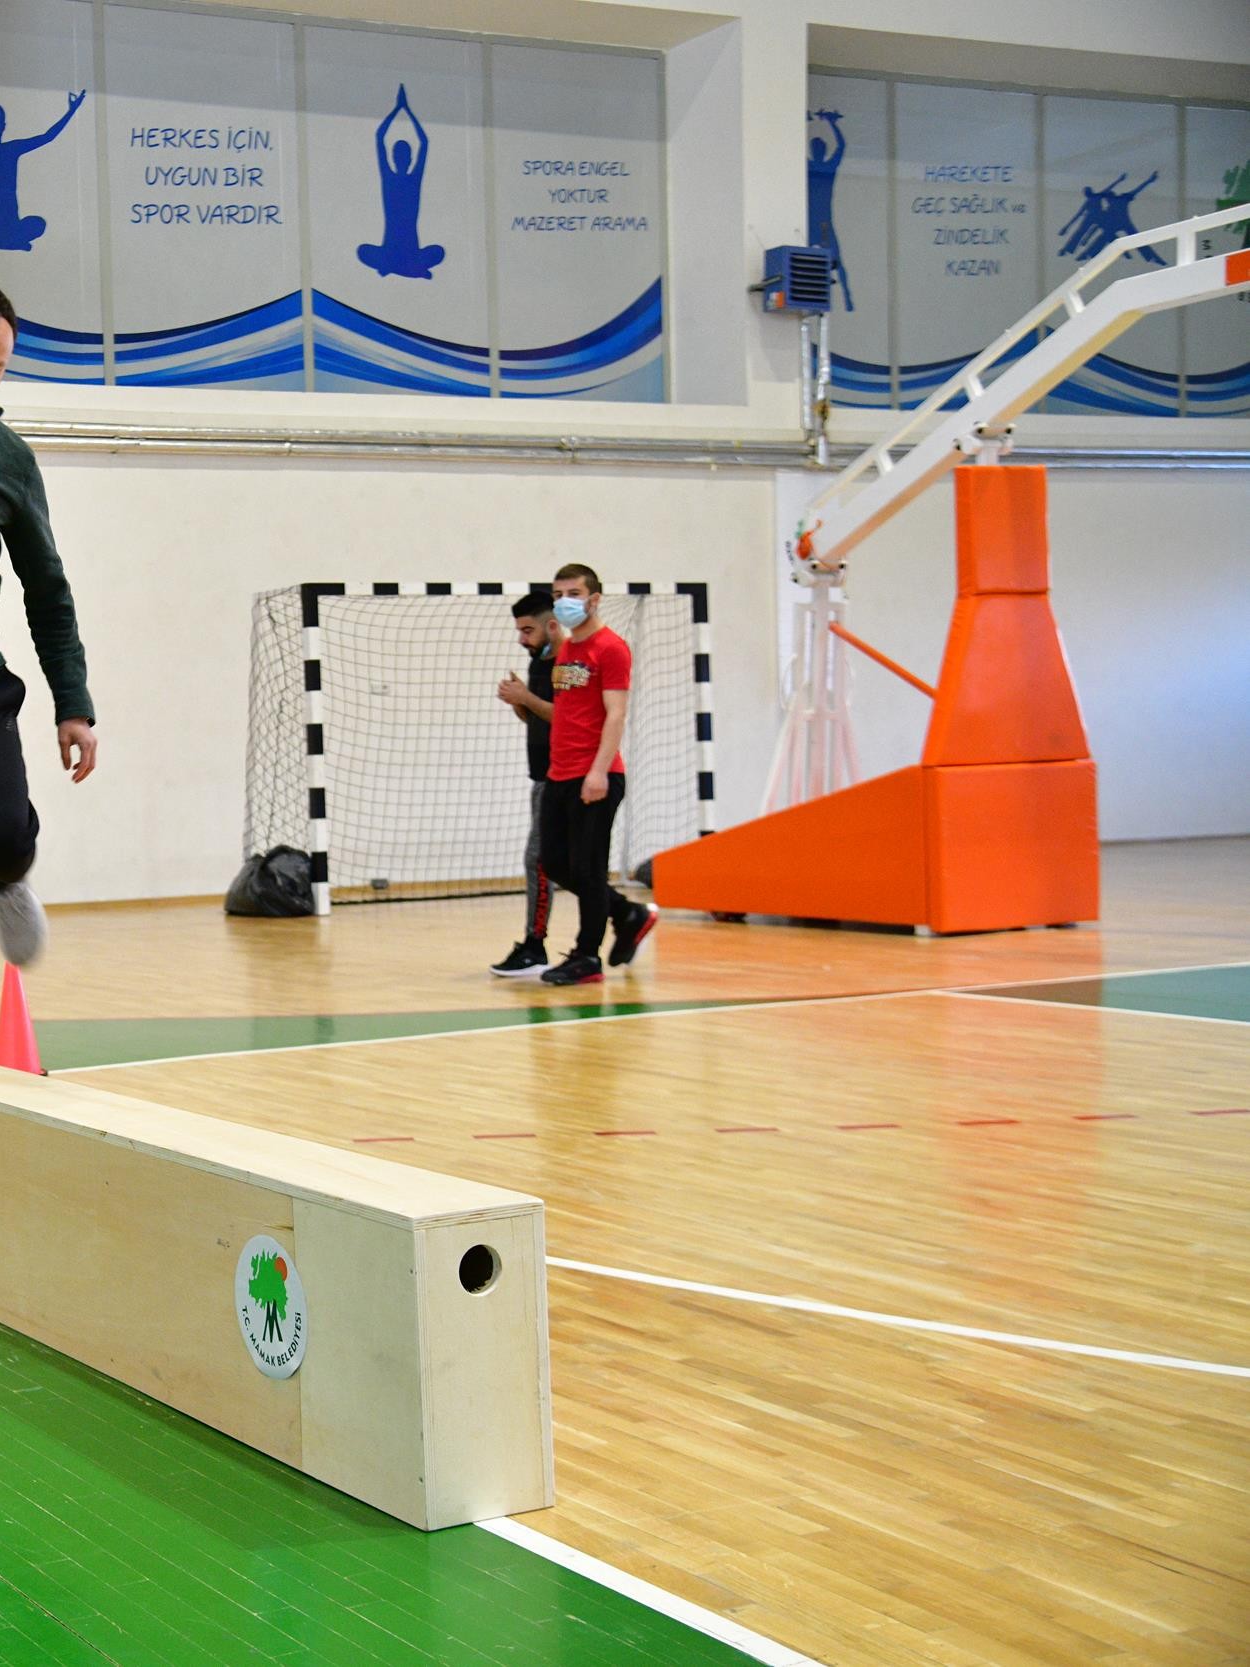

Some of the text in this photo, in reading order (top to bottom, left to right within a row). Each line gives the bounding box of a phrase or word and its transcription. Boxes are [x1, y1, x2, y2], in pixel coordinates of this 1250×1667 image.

[130, 127, 220, 149] HERKES
[145, 164, 264, 187] UYGUN BİR
[522, 160, 631, 176] SPORA ENGEL
[925, 165, 1013, 183] HAREKETE
[548, 188, 610, 204] YOKTUR
[950, 193, 1009, 214] SAĞLIK
[130, 203, 191, 225] SPOR
[511, 216, 650, 231] MAZERET ARAMA
[945, 259, 1001, 276] KAZAN
[250, 1333, 276, 1367] MAMAK
[277, 1312, 302, 1366] BELEDİYESİ
